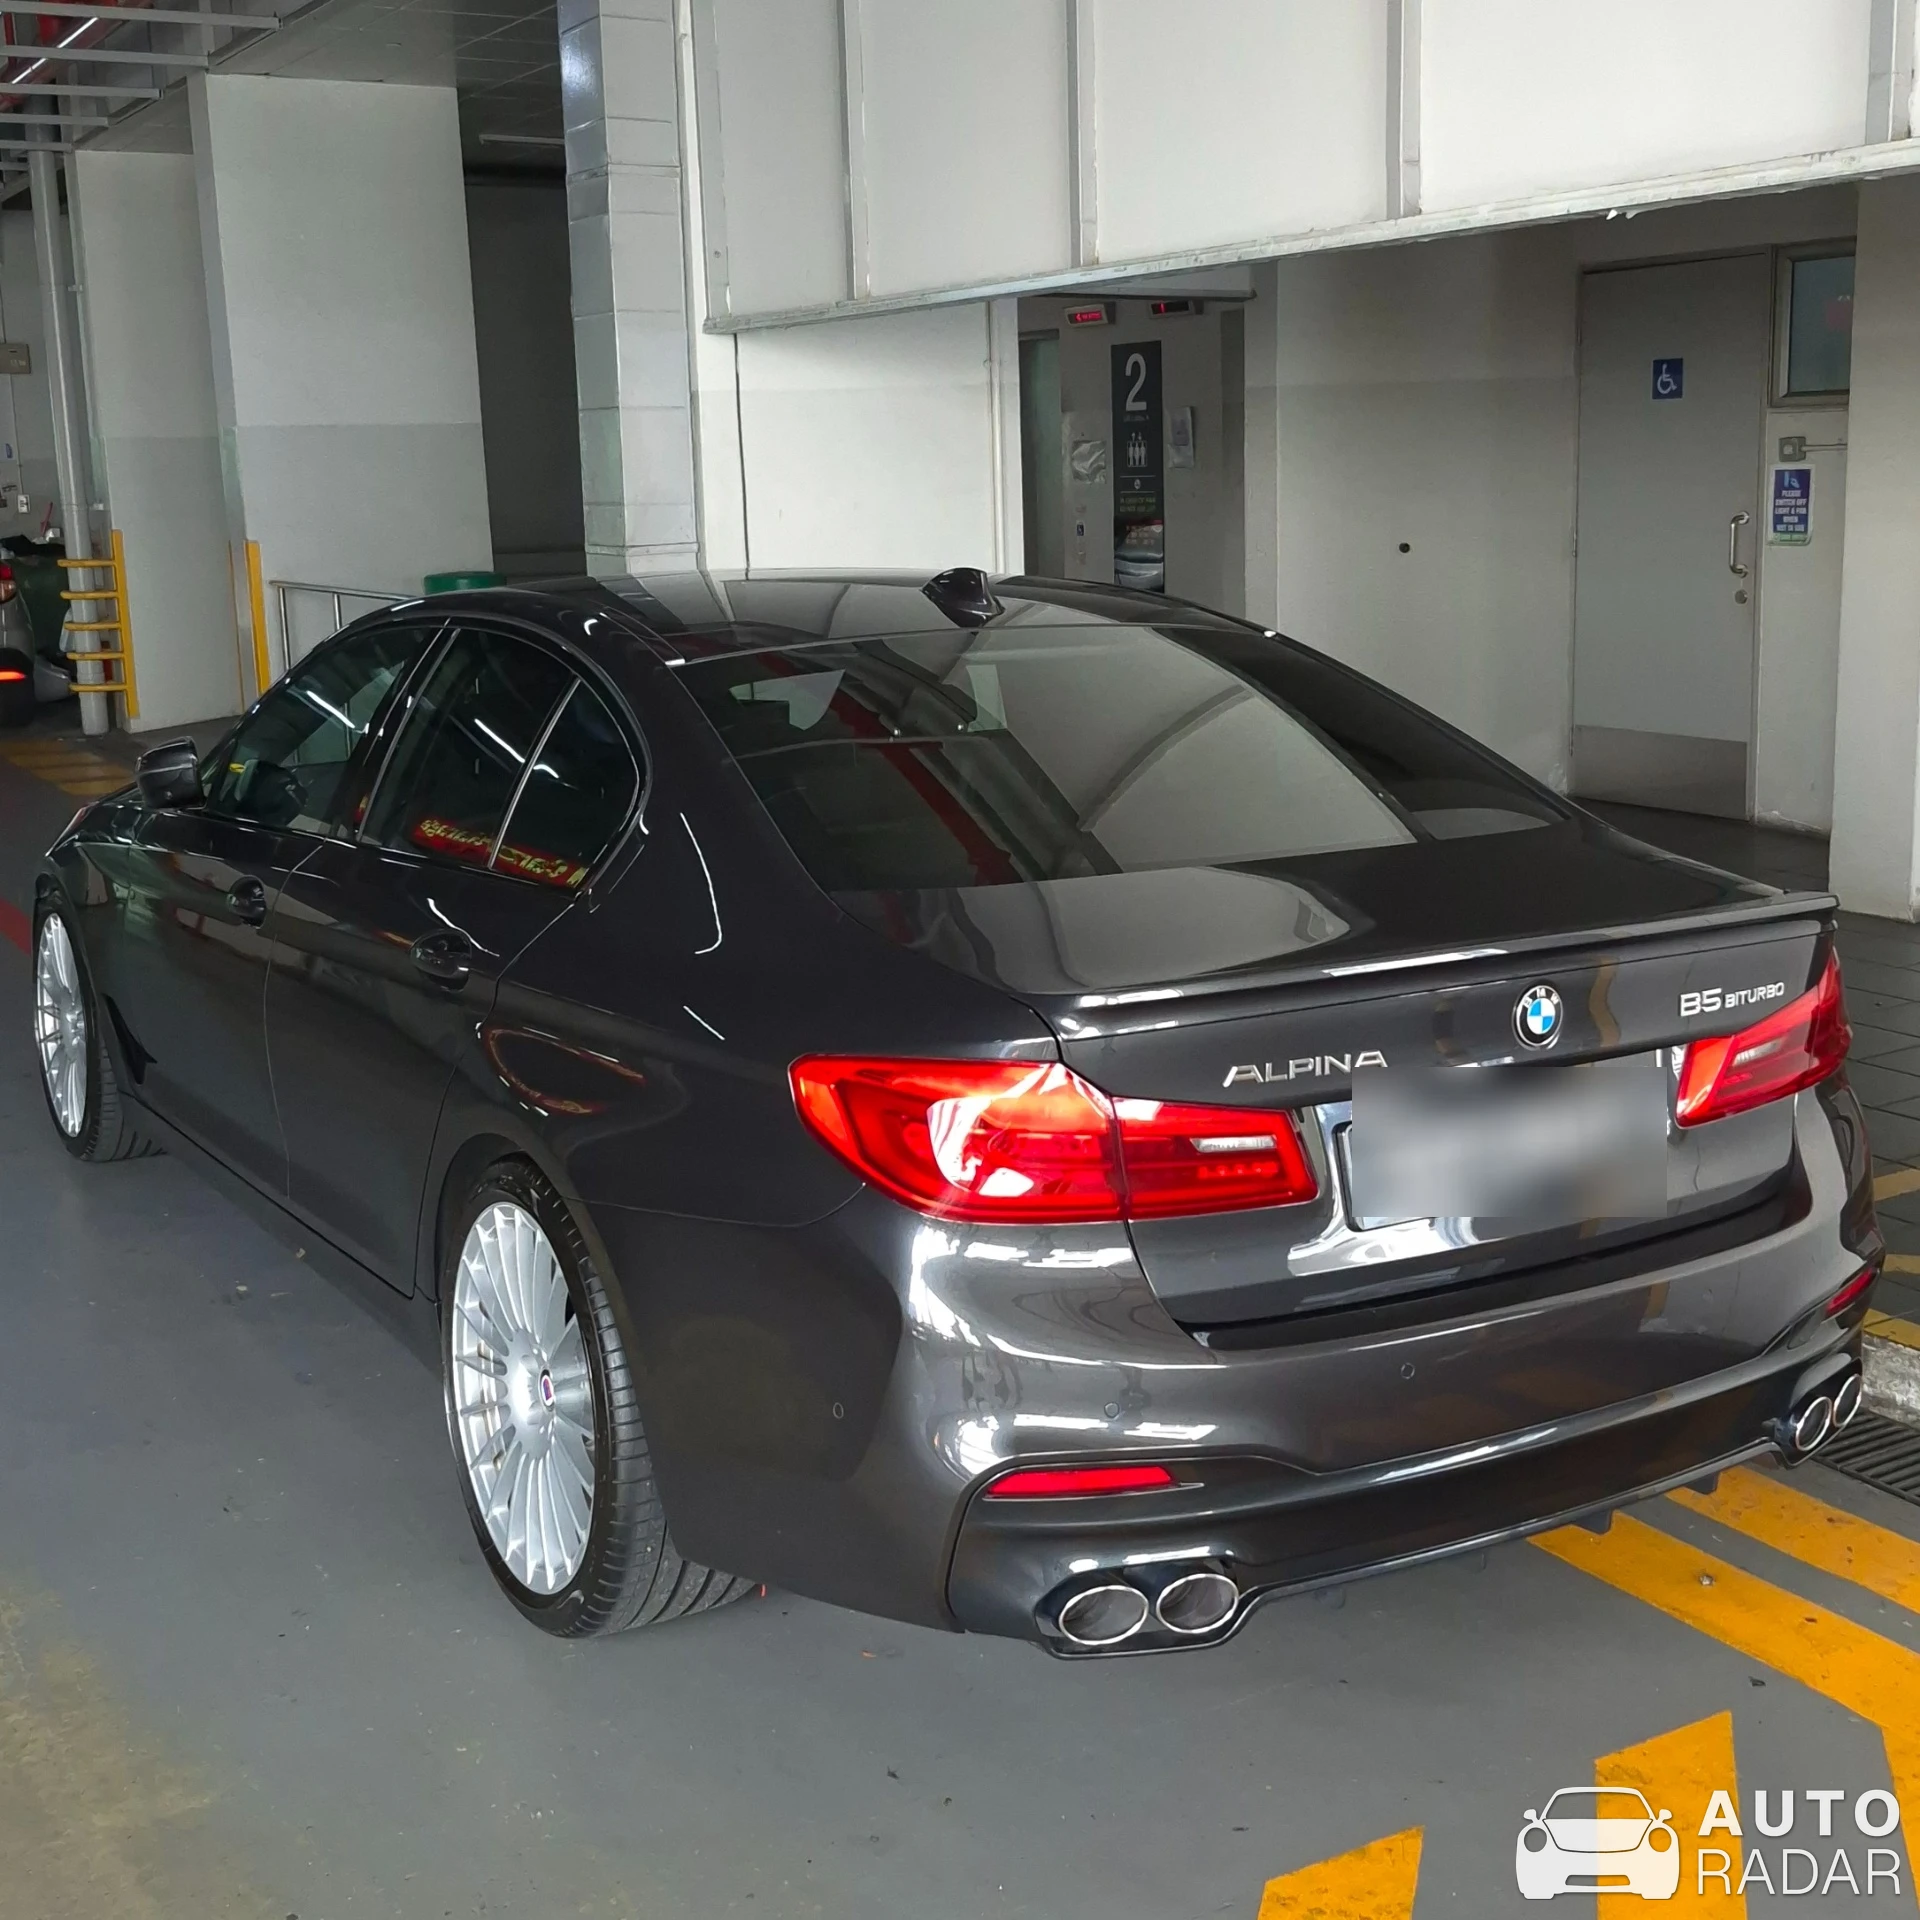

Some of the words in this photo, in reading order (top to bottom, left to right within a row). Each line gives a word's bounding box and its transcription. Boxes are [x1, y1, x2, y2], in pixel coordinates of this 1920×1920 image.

[1125, 352, 1148, 412] 2
[1522, 987, 1560, 1009] BMW
[1680, 987, 1722, 1017] B5
[1724, 982, 1785, 1008] BITURBO
[1222, 1050, 1388, 1088] ALPINA
